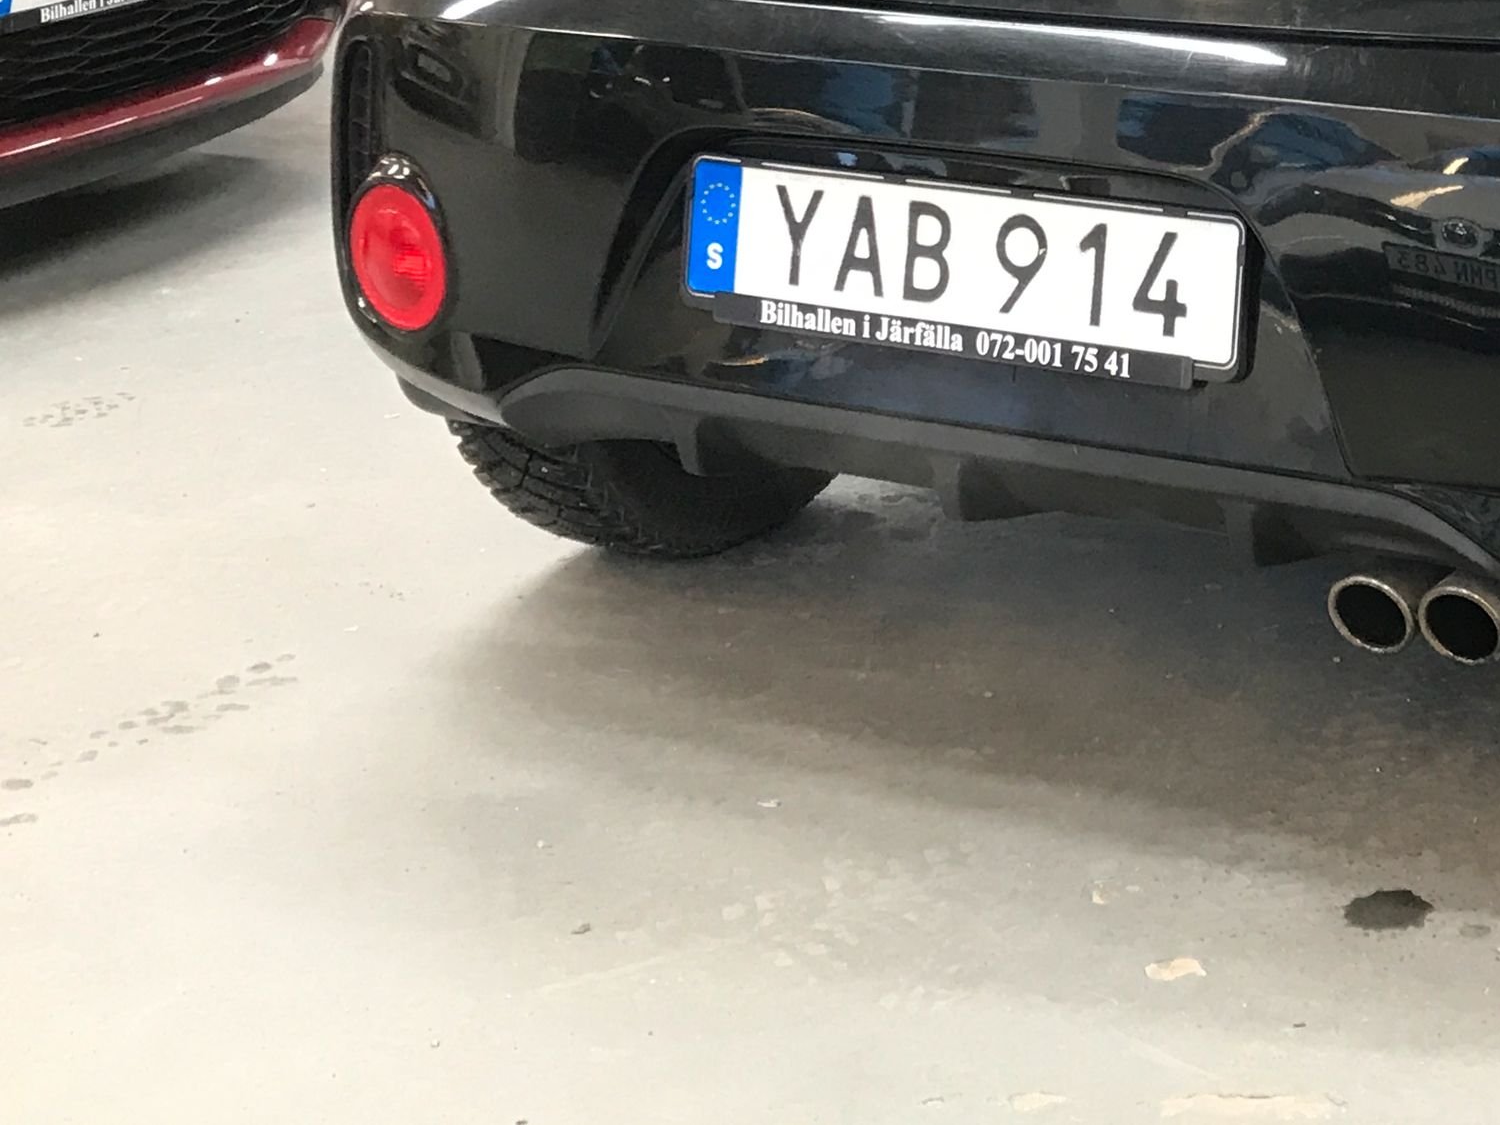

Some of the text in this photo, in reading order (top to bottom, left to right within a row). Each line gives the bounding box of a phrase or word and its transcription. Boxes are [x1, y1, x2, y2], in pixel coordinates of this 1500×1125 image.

[706, 241, 724, 270] S
[775, 184, 1188, 338] YAB 914
[759, 299, 1131, 378] Bilhallen i Järfälla 072-001 75 41
